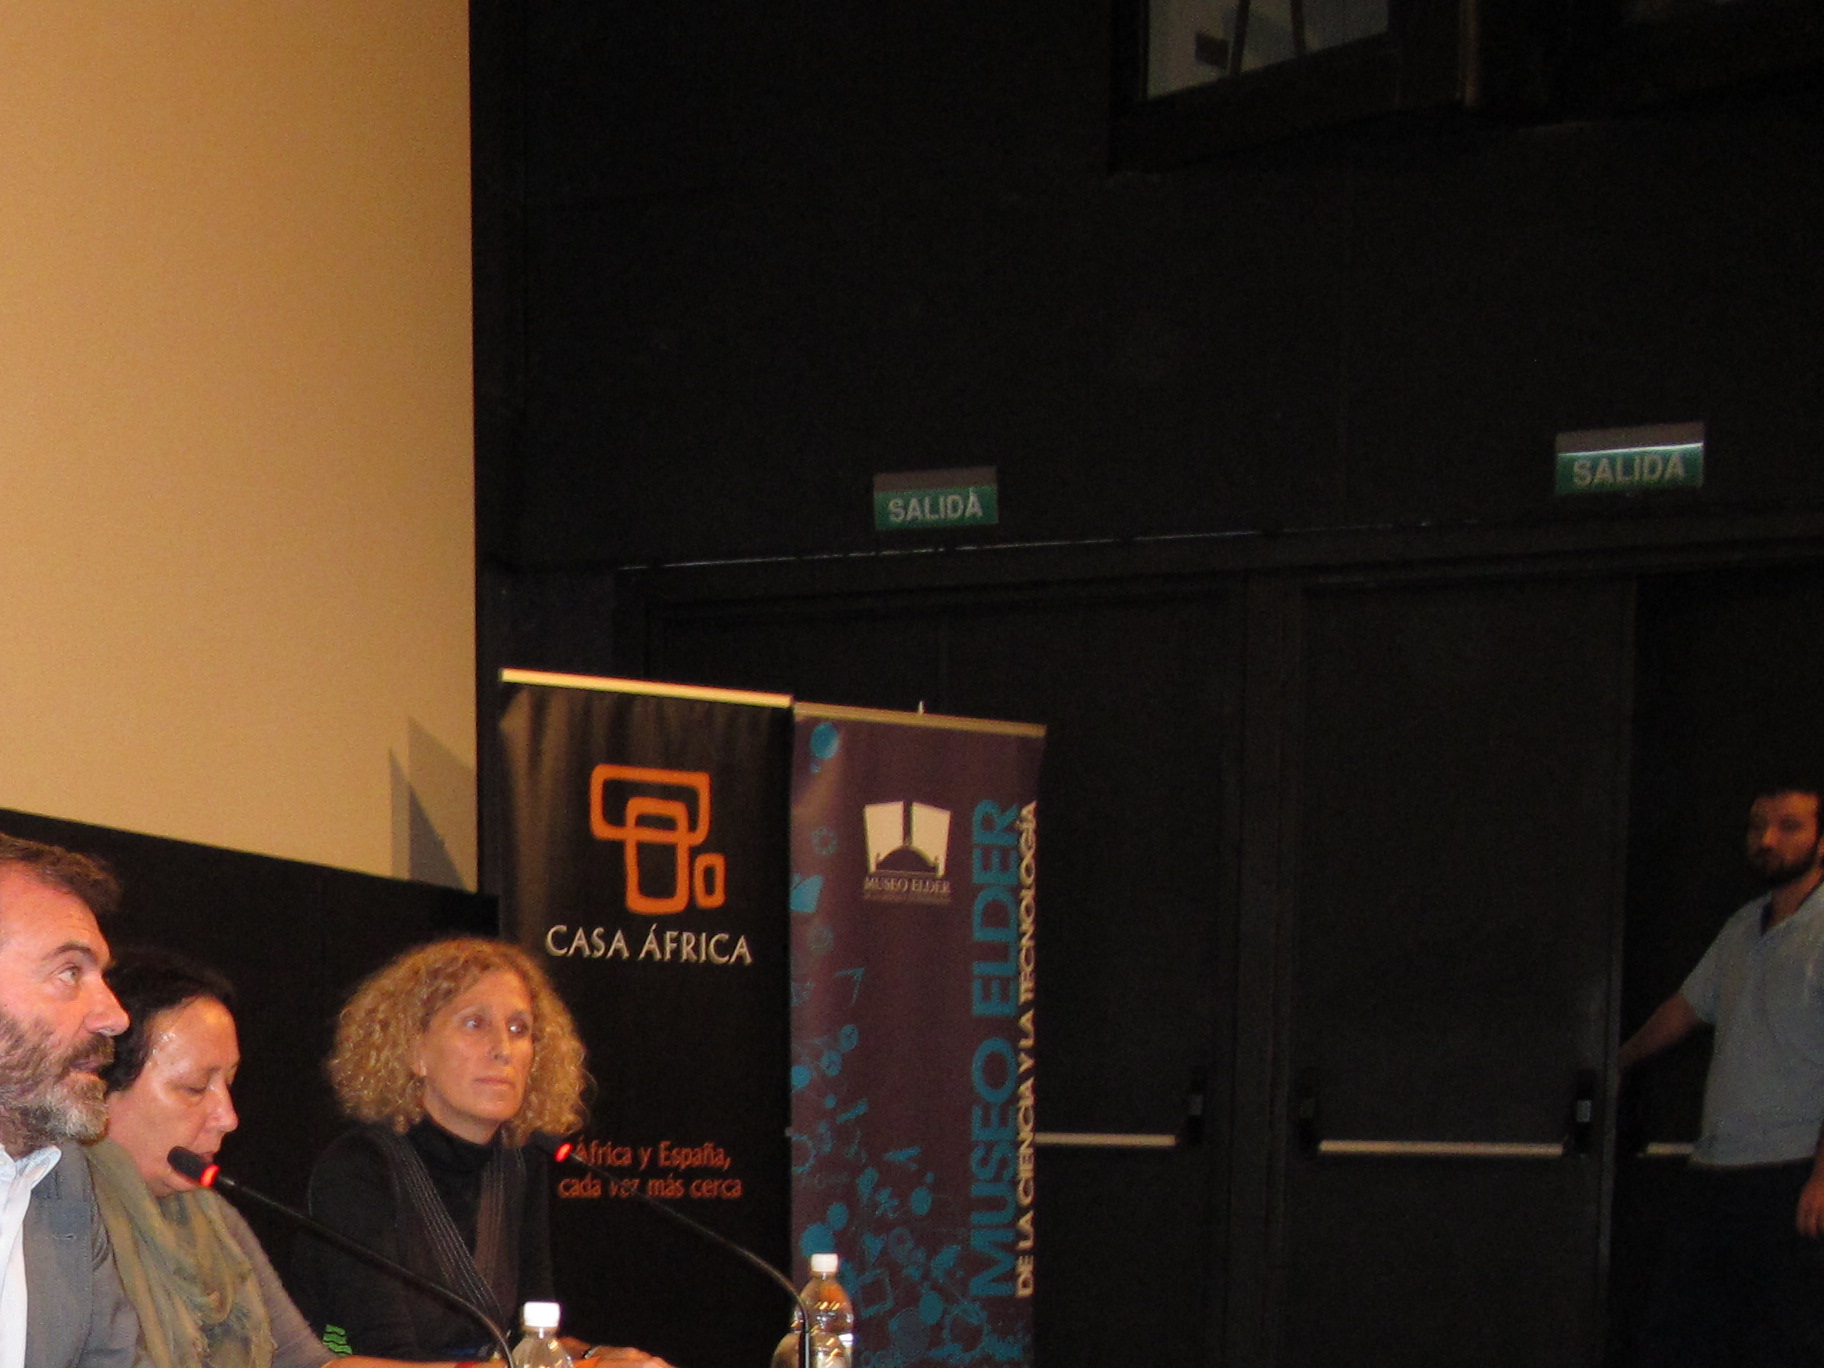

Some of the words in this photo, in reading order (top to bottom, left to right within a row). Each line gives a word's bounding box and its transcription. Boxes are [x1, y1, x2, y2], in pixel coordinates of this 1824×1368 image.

[1573, 453, 1685, 487] SALIDA
[887, 493, 983, 523] SALIDA
[972, 800, 1020, 1016] ELDER
[545, 924, 630, 959] CASA
[636, 923, 753, 966] ÁFRICA
[1018, 1009, 1035, 1048] LA
[1018, 1052, 1035, 1075] Y
[576, 1135, 633, 1167] África
[638, 1147, 652, 1171] y
[658, 1140, 731, 1171] España,
[1017, 1077, 1035, 1206] CIENCIA
[558, 1172, 602, 1199] cada
[609, 1178, 641, 1198] vez
[645, 1172, 685, 1199] más
[689, 1179, 743, 1199] cerca
[971, 1037, 1018, 1297] MUSEO
[1017, 1211, 1034, 1249] LA
[1016, 1255, 1035, 1297] DE
